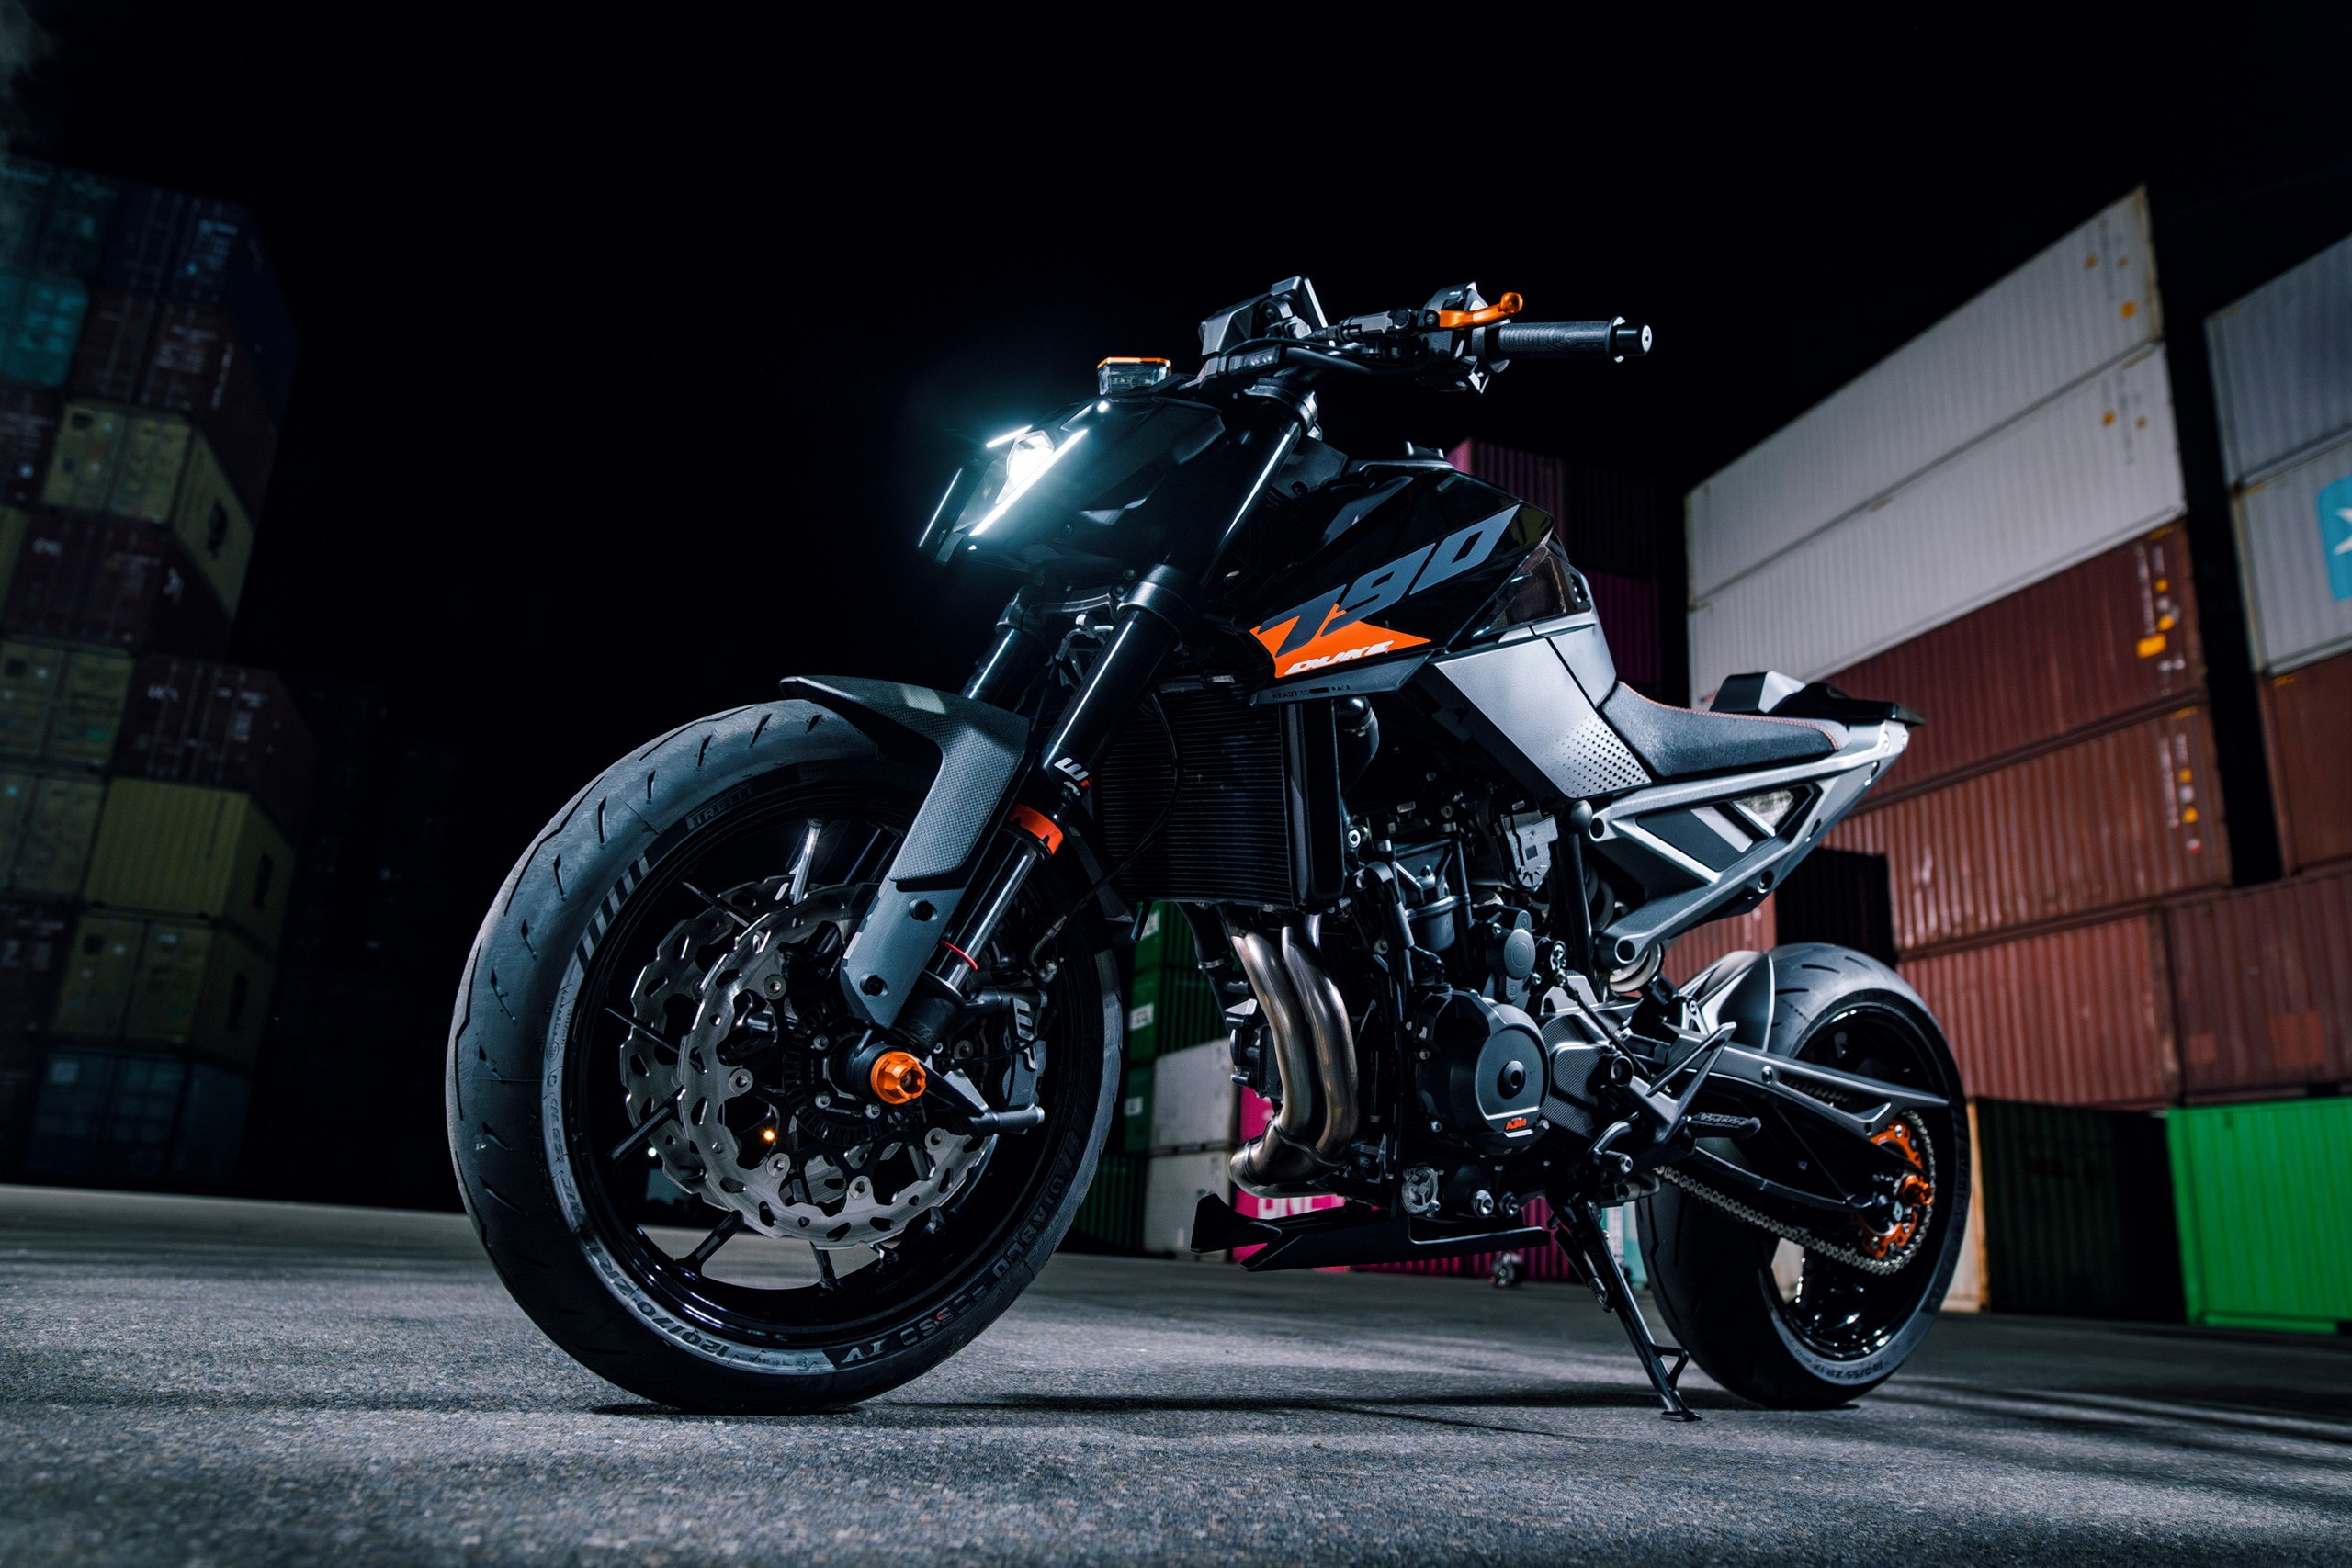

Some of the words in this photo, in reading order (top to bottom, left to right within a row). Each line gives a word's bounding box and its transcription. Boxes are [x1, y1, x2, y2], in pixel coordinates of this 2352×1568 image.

[1258, 504, 1521, 658] 790
[1284, 640, 1395, 675] DUKE
[1272, 691, 1298, 699] READY
[1505, 1117, 1527, 1131] KTM
[992, 1176, 1068, 1278] DIABLO
[638, 1302, 729, 1357] 120/70
